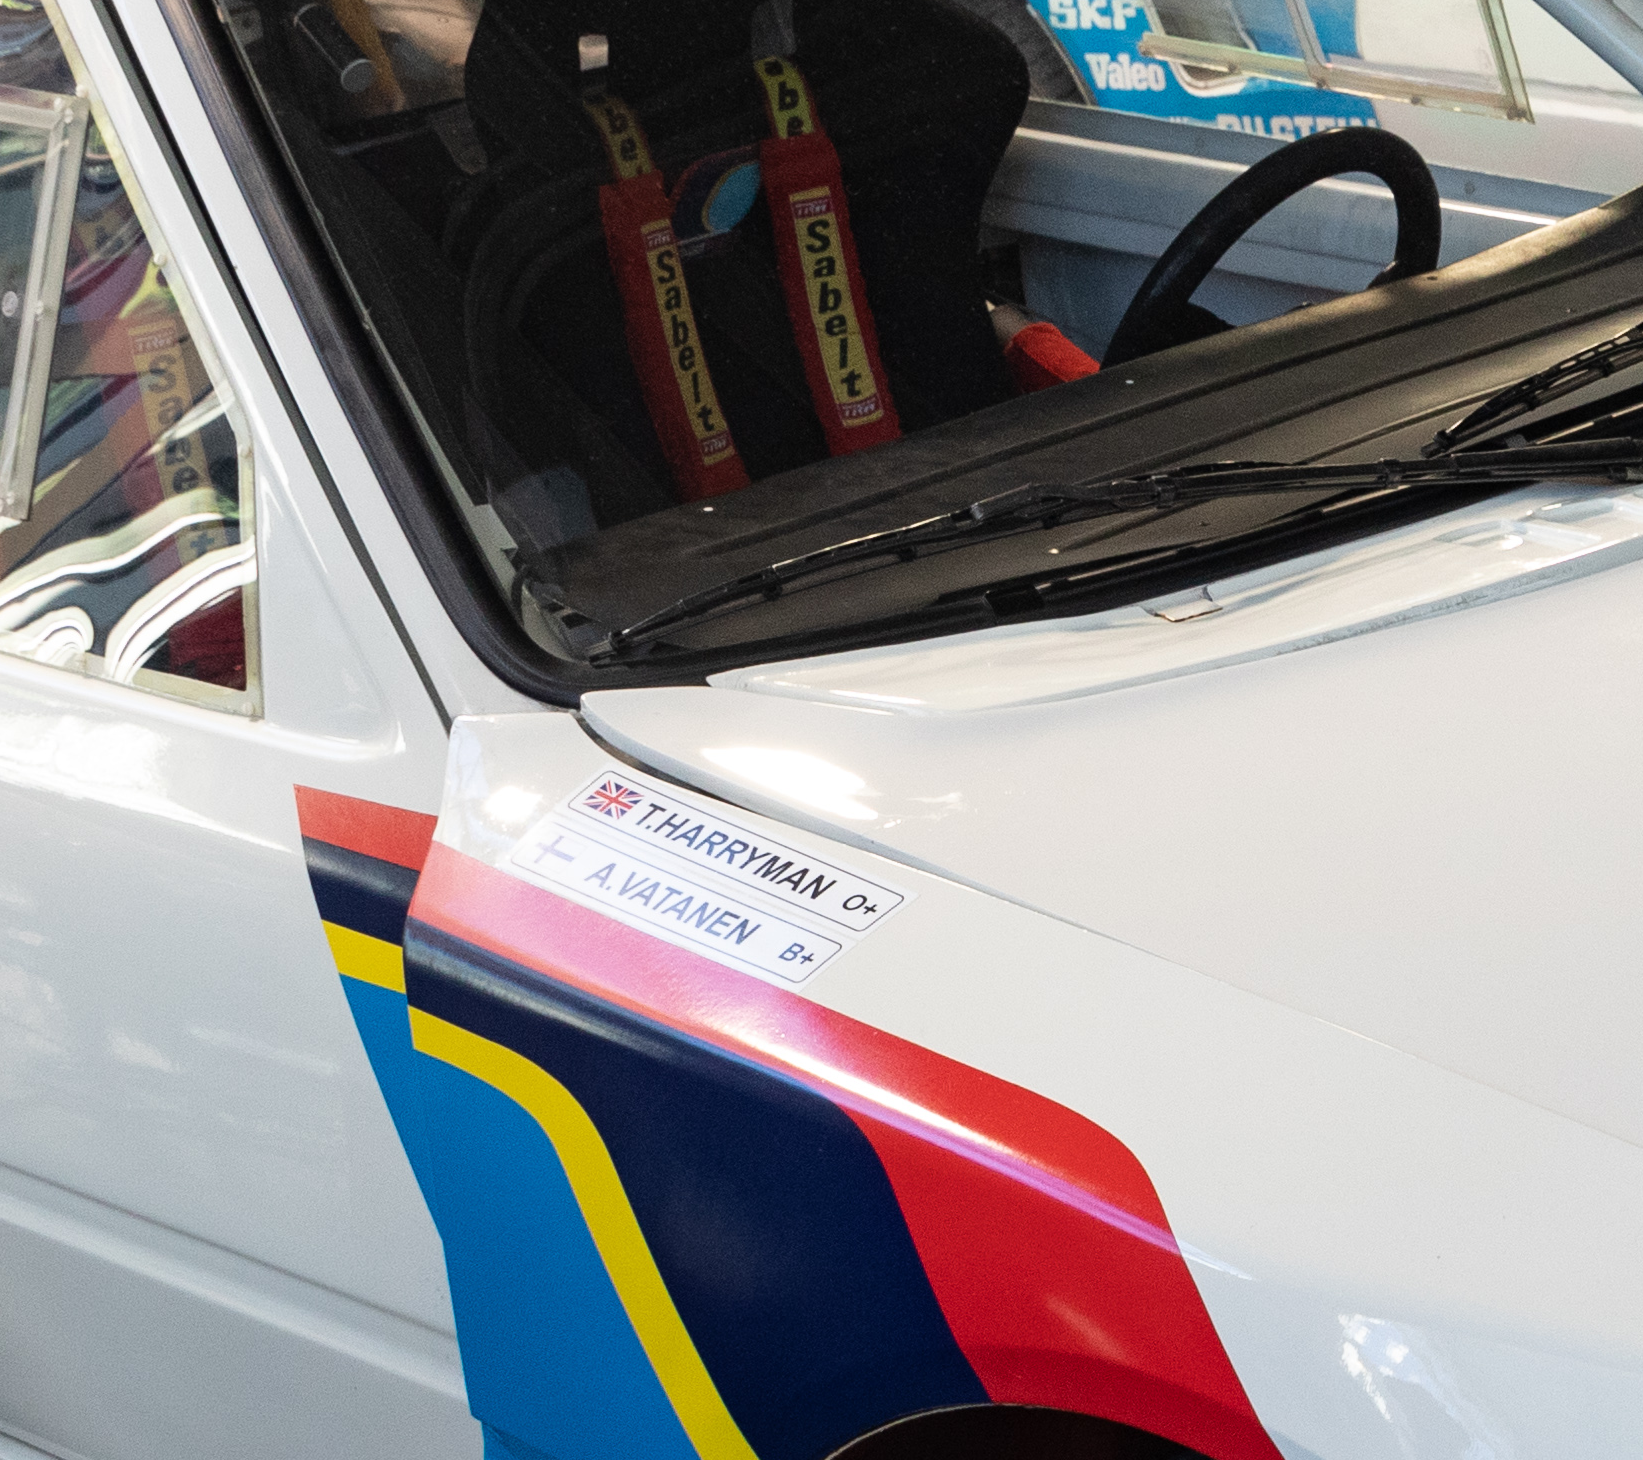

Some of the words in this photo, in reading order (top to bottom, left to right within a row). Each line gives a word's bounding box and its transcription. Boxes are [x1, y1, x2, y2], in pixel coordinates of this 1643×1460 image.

[1084, 52, 1167, 92] Valeo
[655, 249, 716, 433] Sabelt
[804, 217, 864, 399] Sabelt
[635, 801, 836, 903] T.HARRYMAN
[585, 861, 761, 947] A.VATANEN
[778, 940, 816, 970] B+
